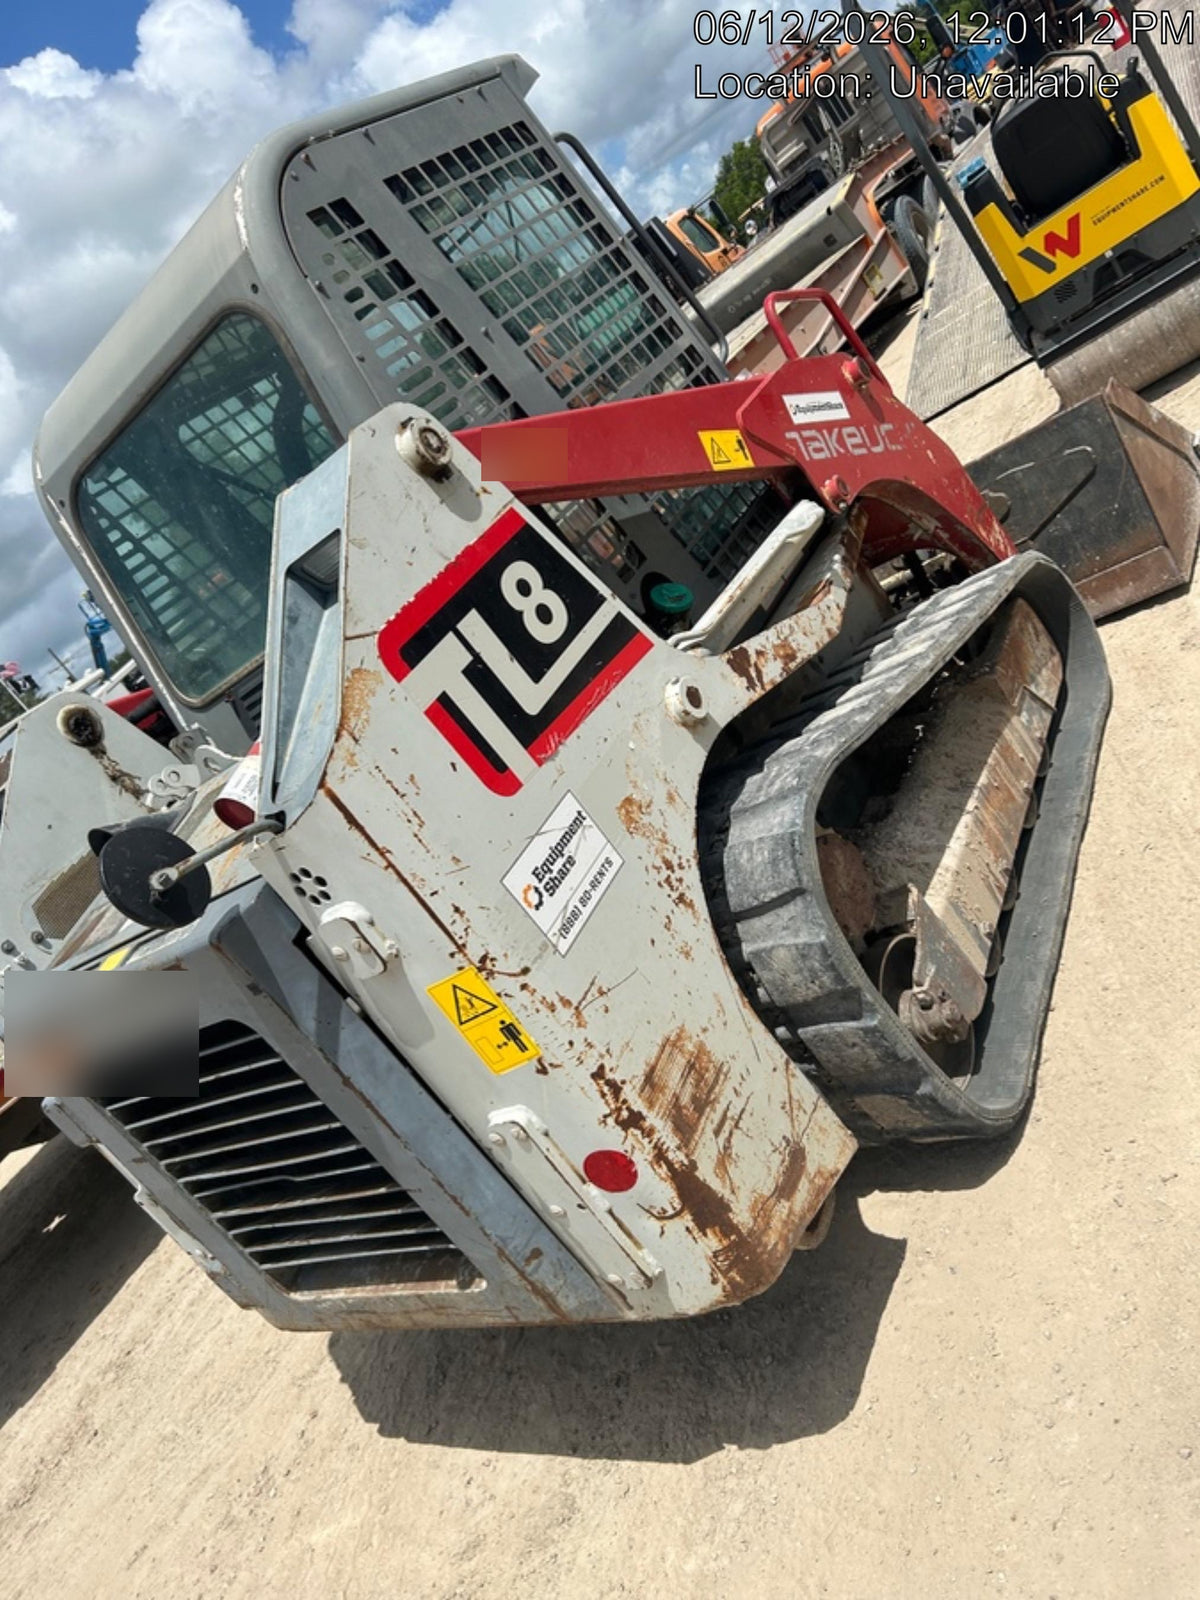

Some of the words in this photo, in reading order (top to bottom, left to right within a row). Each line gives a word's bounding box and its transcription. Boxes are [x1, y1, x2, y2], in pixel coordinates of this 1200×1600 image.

[399, 560, 617, 786] TL8
[531, 810, 587, 884] Equipment
[543, 855, 577, 897] Share
[558, 905, 583, 940] (888)
[578, 856, 614, 908] 80-RENTS
